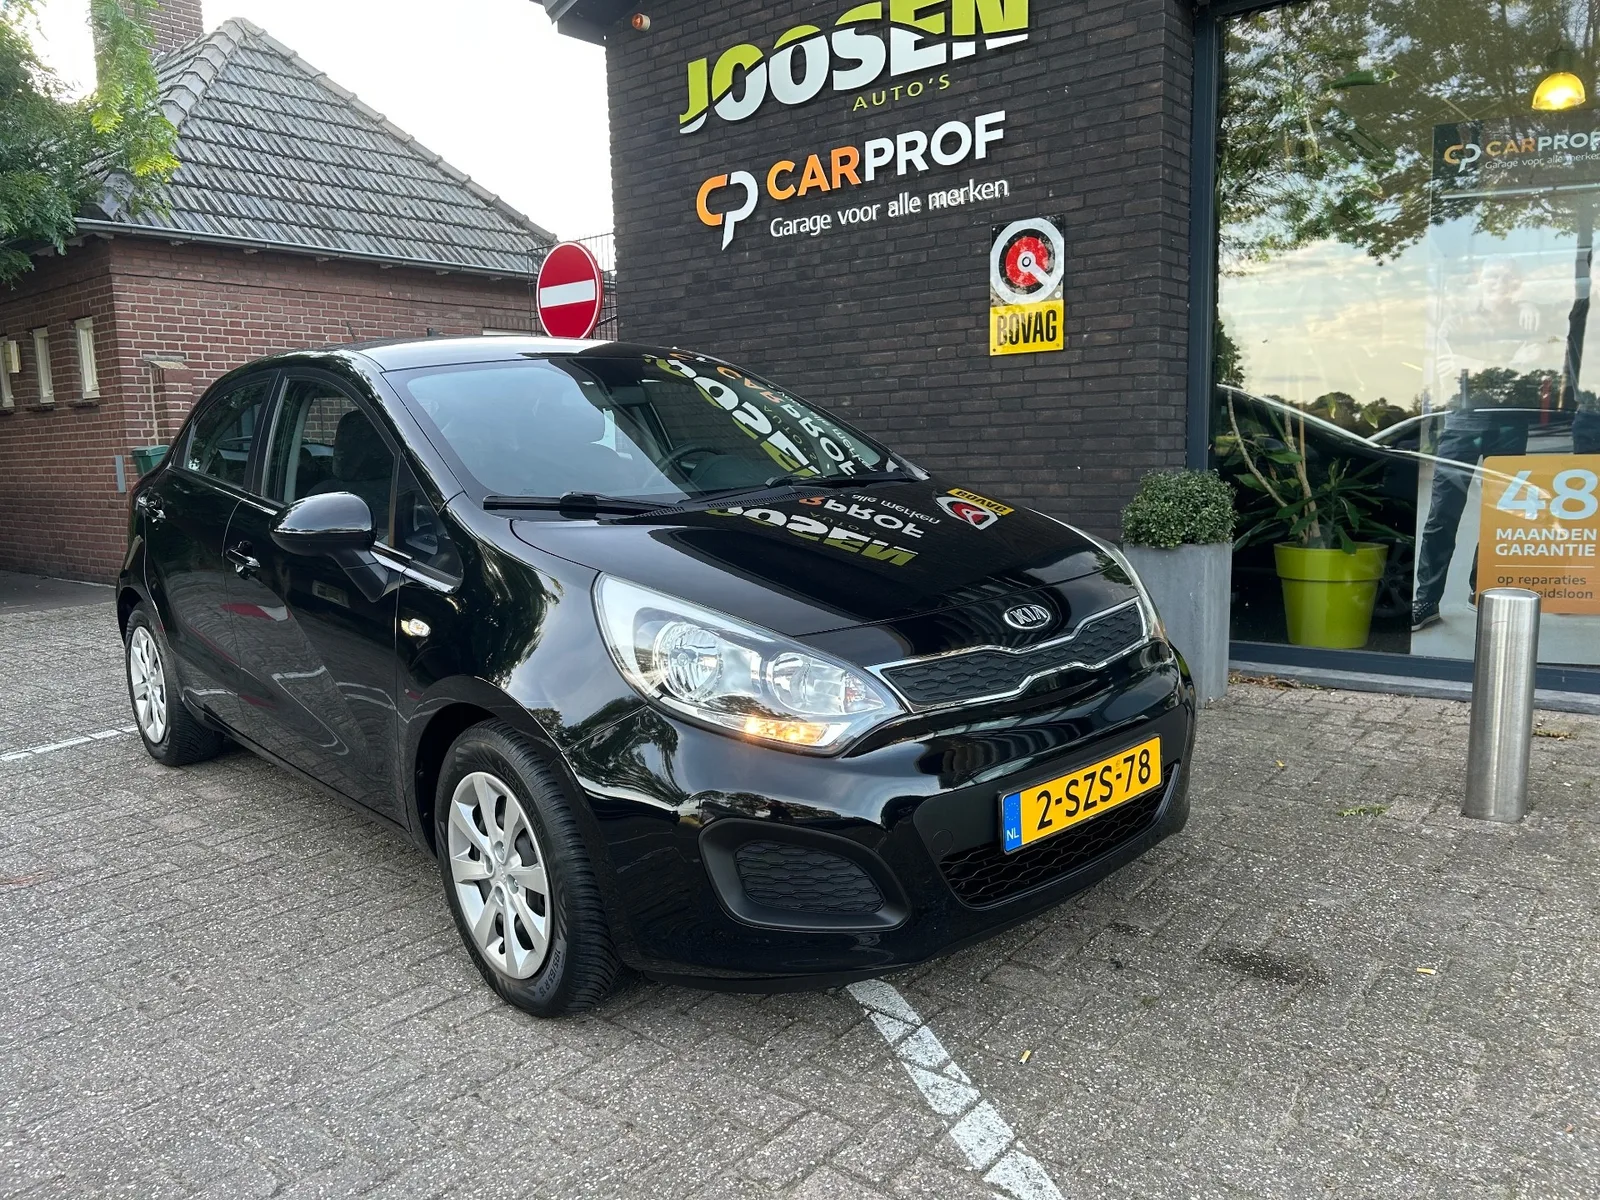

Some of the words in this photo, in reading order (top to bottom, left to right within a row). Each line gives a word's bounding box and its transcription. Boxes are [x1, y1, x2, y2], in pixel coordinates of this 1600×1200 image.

[679, 0, 1029, 134] JOOSEN
[852, 73, 951, 111] AUTO'S
[766, 110, 1006, 200] CARPROF
[1486, 131, 1600, 156] CARPROF
[1485, 159, 1518, 170] Garage
[1547, 154, 1563, 164] alle
[769, 212, 831, 238] Garage
[837, 201, 880, 223] voor
[888, 193, 921, 217] alle
[928, 177, 1009, 209] merken
[997, 309, 1057, 347] BOVAG
[1496, 468, 1599, 520] 48
[1495, 528, 1598, 541] MAANDEN
[1495, 543, 1596, 557] GARANTIE
[1497, 575, 1514, 586] op
[1518, 574, 1587, 586] reparaties
[1528, 587, 1593, 600] eidsloon
[1011, 605, 1048, 625] KIA
[1036, 748, 1151, 831] 2-SZS-78
[1006, 827, 1020, 842] NL
